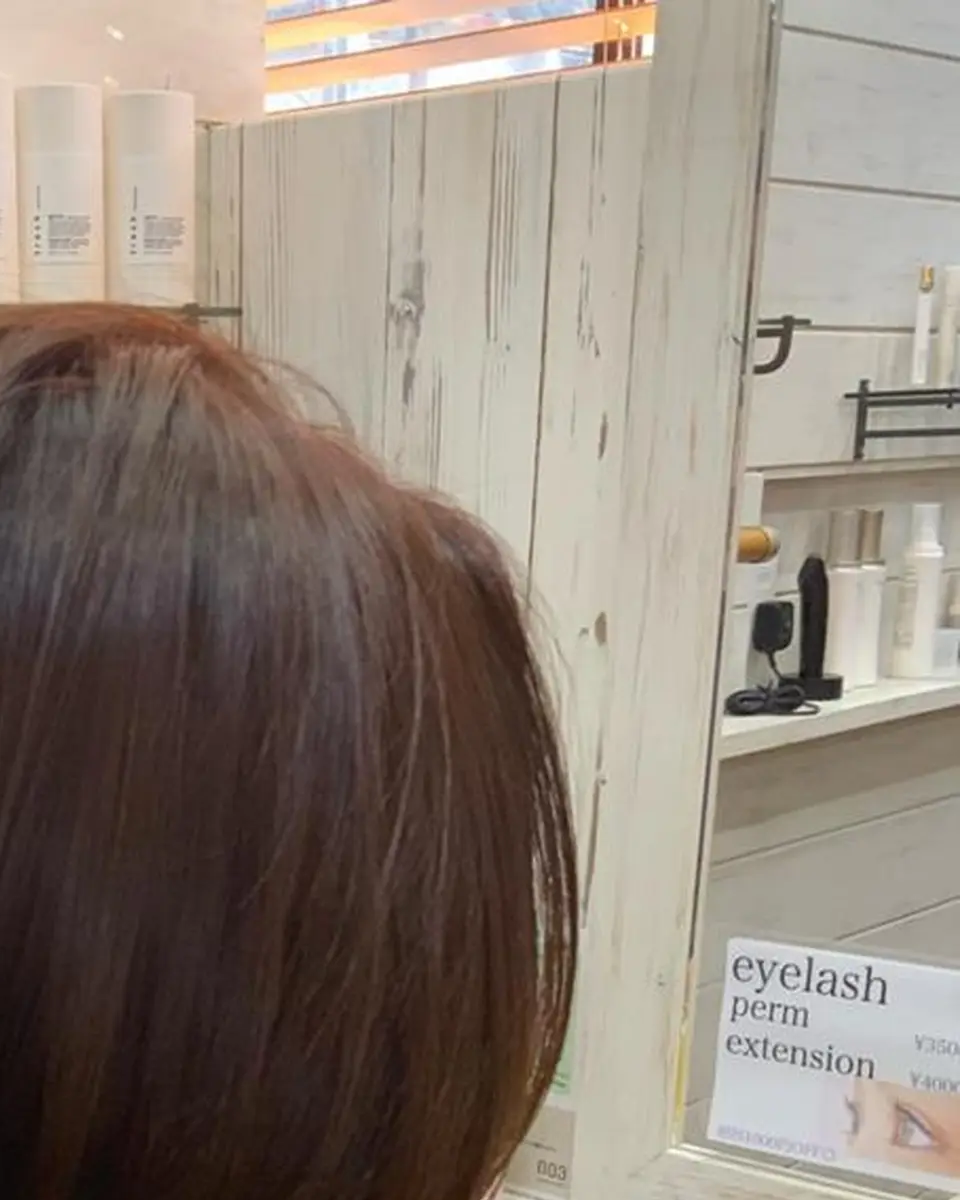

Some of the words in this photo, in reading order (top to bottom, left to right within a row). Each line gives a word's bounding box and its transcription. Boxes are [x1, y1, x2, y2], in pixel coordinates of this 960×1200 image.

[731, 953, 890, 1006] eyelash
[729, 994, 811, 1029] perm
[725, 1032, 877, 1080] extension
